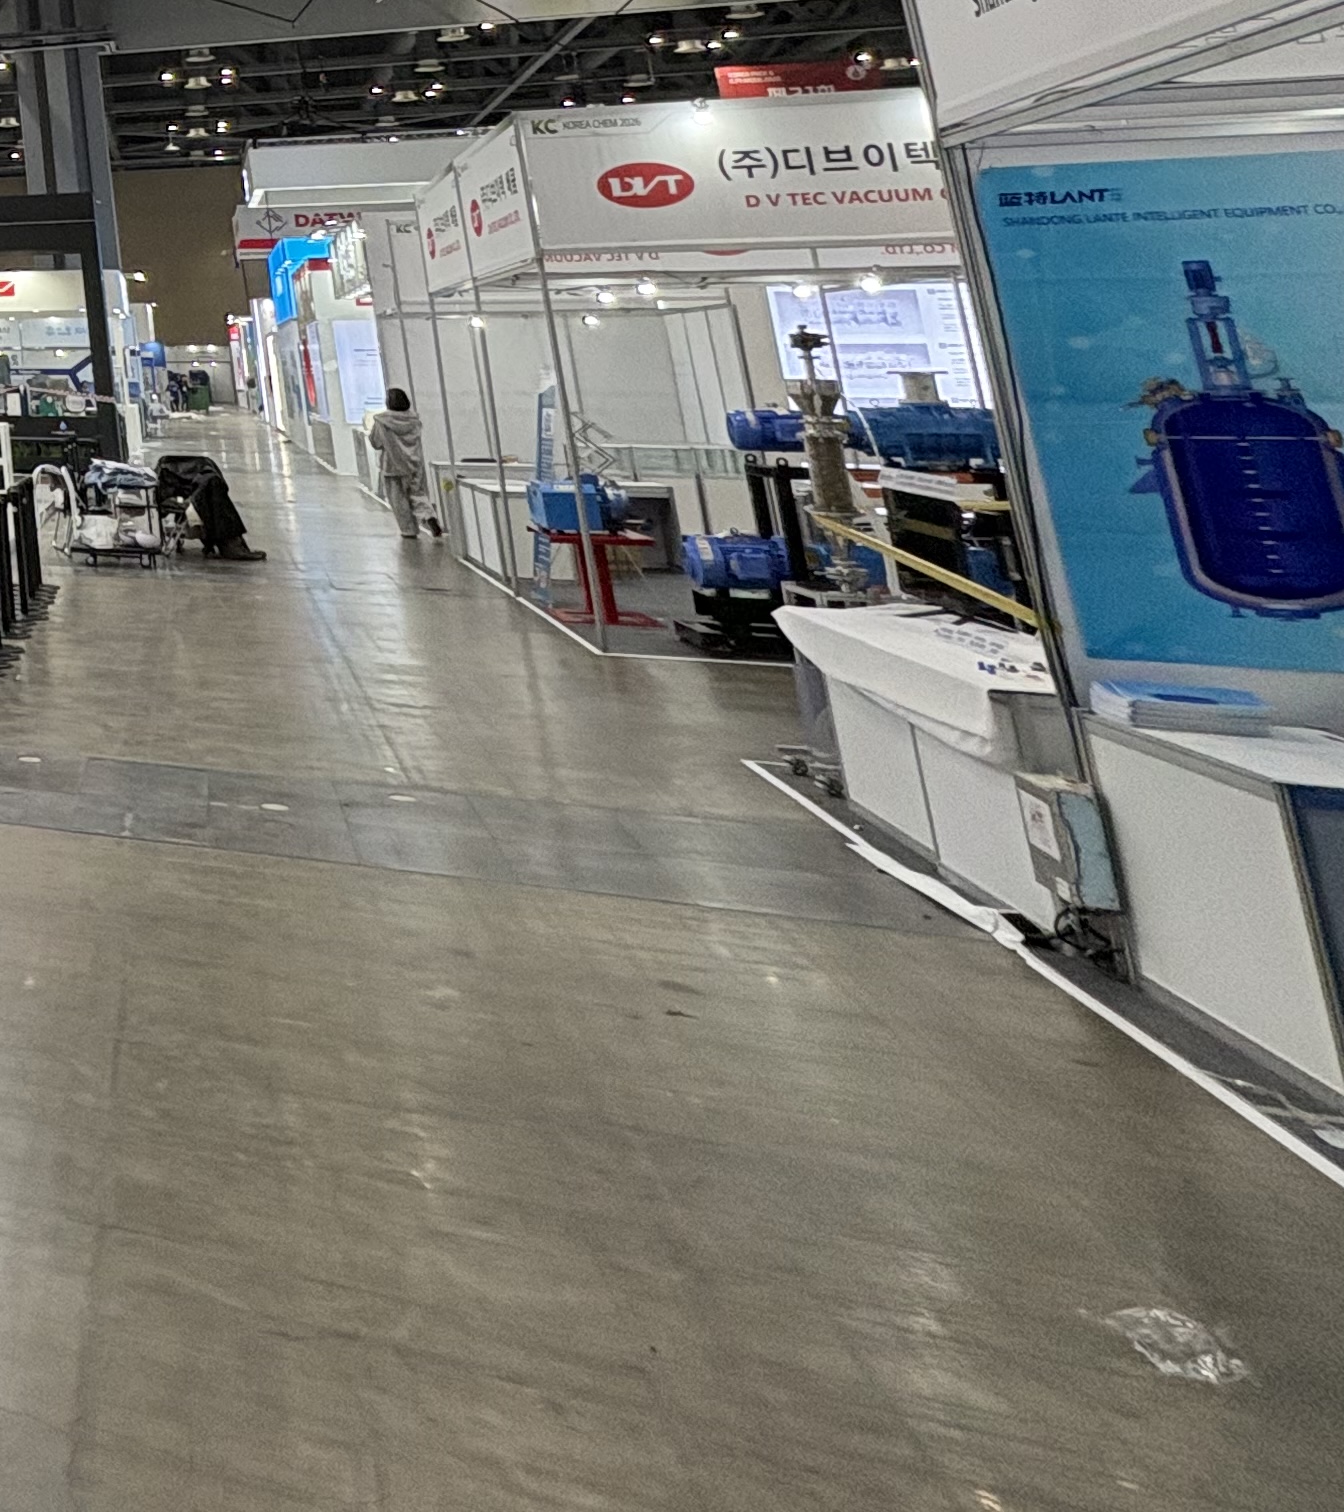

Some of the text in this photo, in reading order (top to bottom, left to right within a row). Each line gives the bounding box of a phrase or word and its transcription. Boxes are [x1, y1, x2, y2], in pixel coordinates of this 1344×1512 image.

[531, 119, 558, 134] KC
[563, 120, 592, 130] KOREA
[718, 139, 940, 181] (주)디브이텍
[745, 194, 761, 208] D
[765, 193, 781, 207] V
[786, 191, 827, 207] TEC
[831, 187, 934, 205] VACUUM
[1085, 212, 1131, 224] LANTE
[1224, 204, 1308, 219] EQUIPMENT
